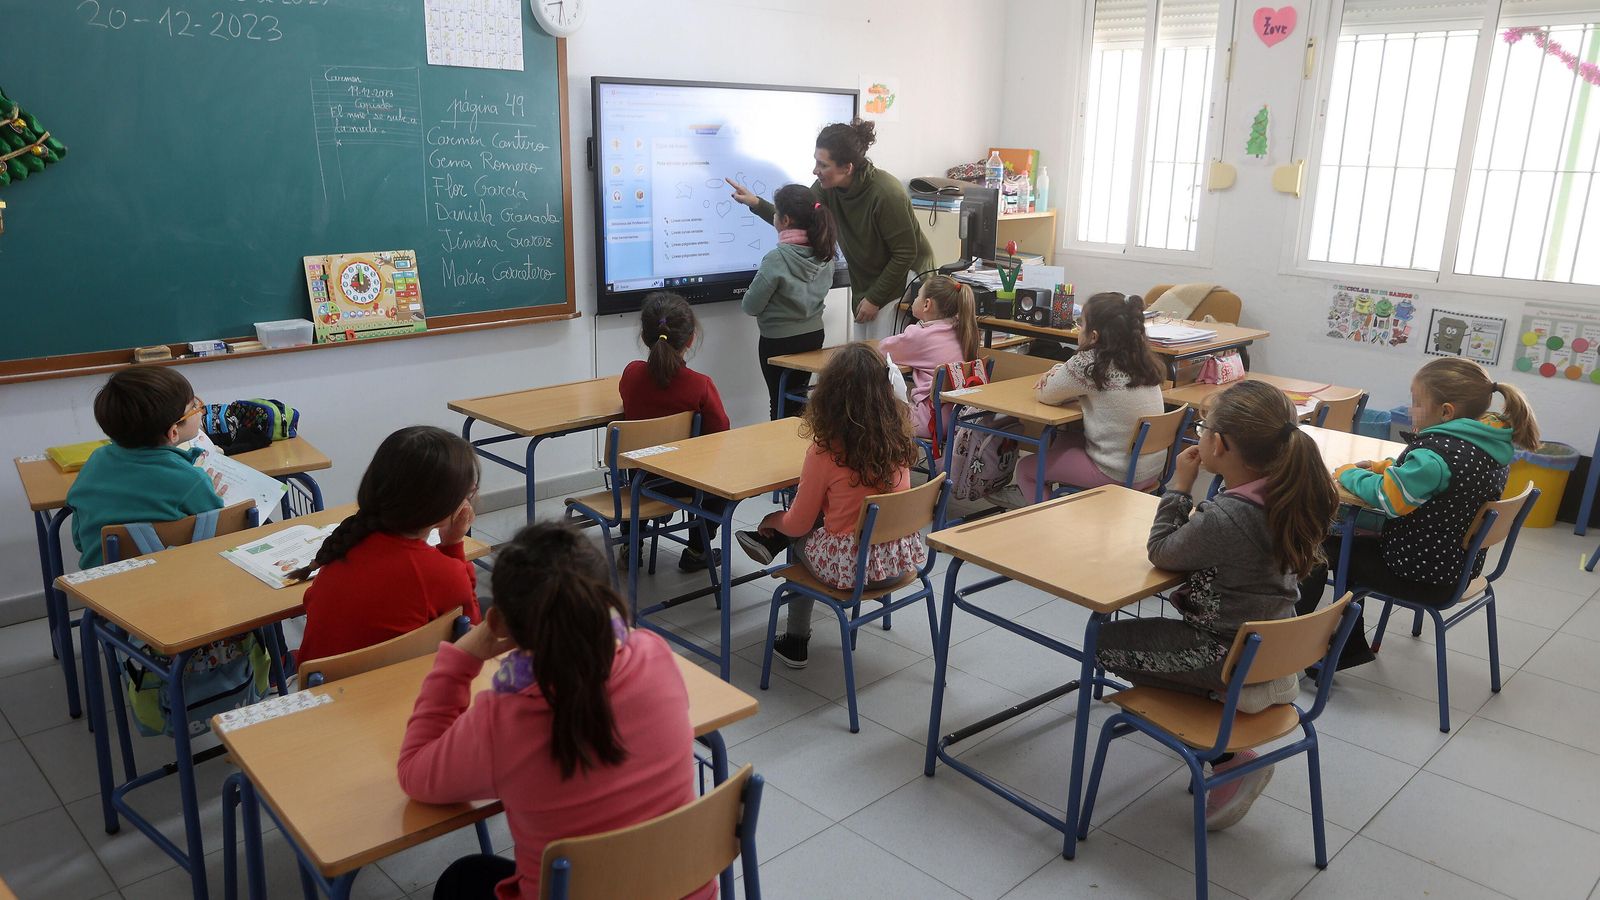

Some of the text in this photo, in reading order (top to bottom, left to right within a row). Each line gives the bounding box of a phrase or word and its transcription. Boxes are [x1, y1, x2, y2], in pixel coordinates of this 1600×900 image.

[446, 88, 525, 134] página 49
[491, 129, 552, 151] Cantero
[428, 148, 543, 174] Gema Romero
[431, 173, 528, 201] Flor García
